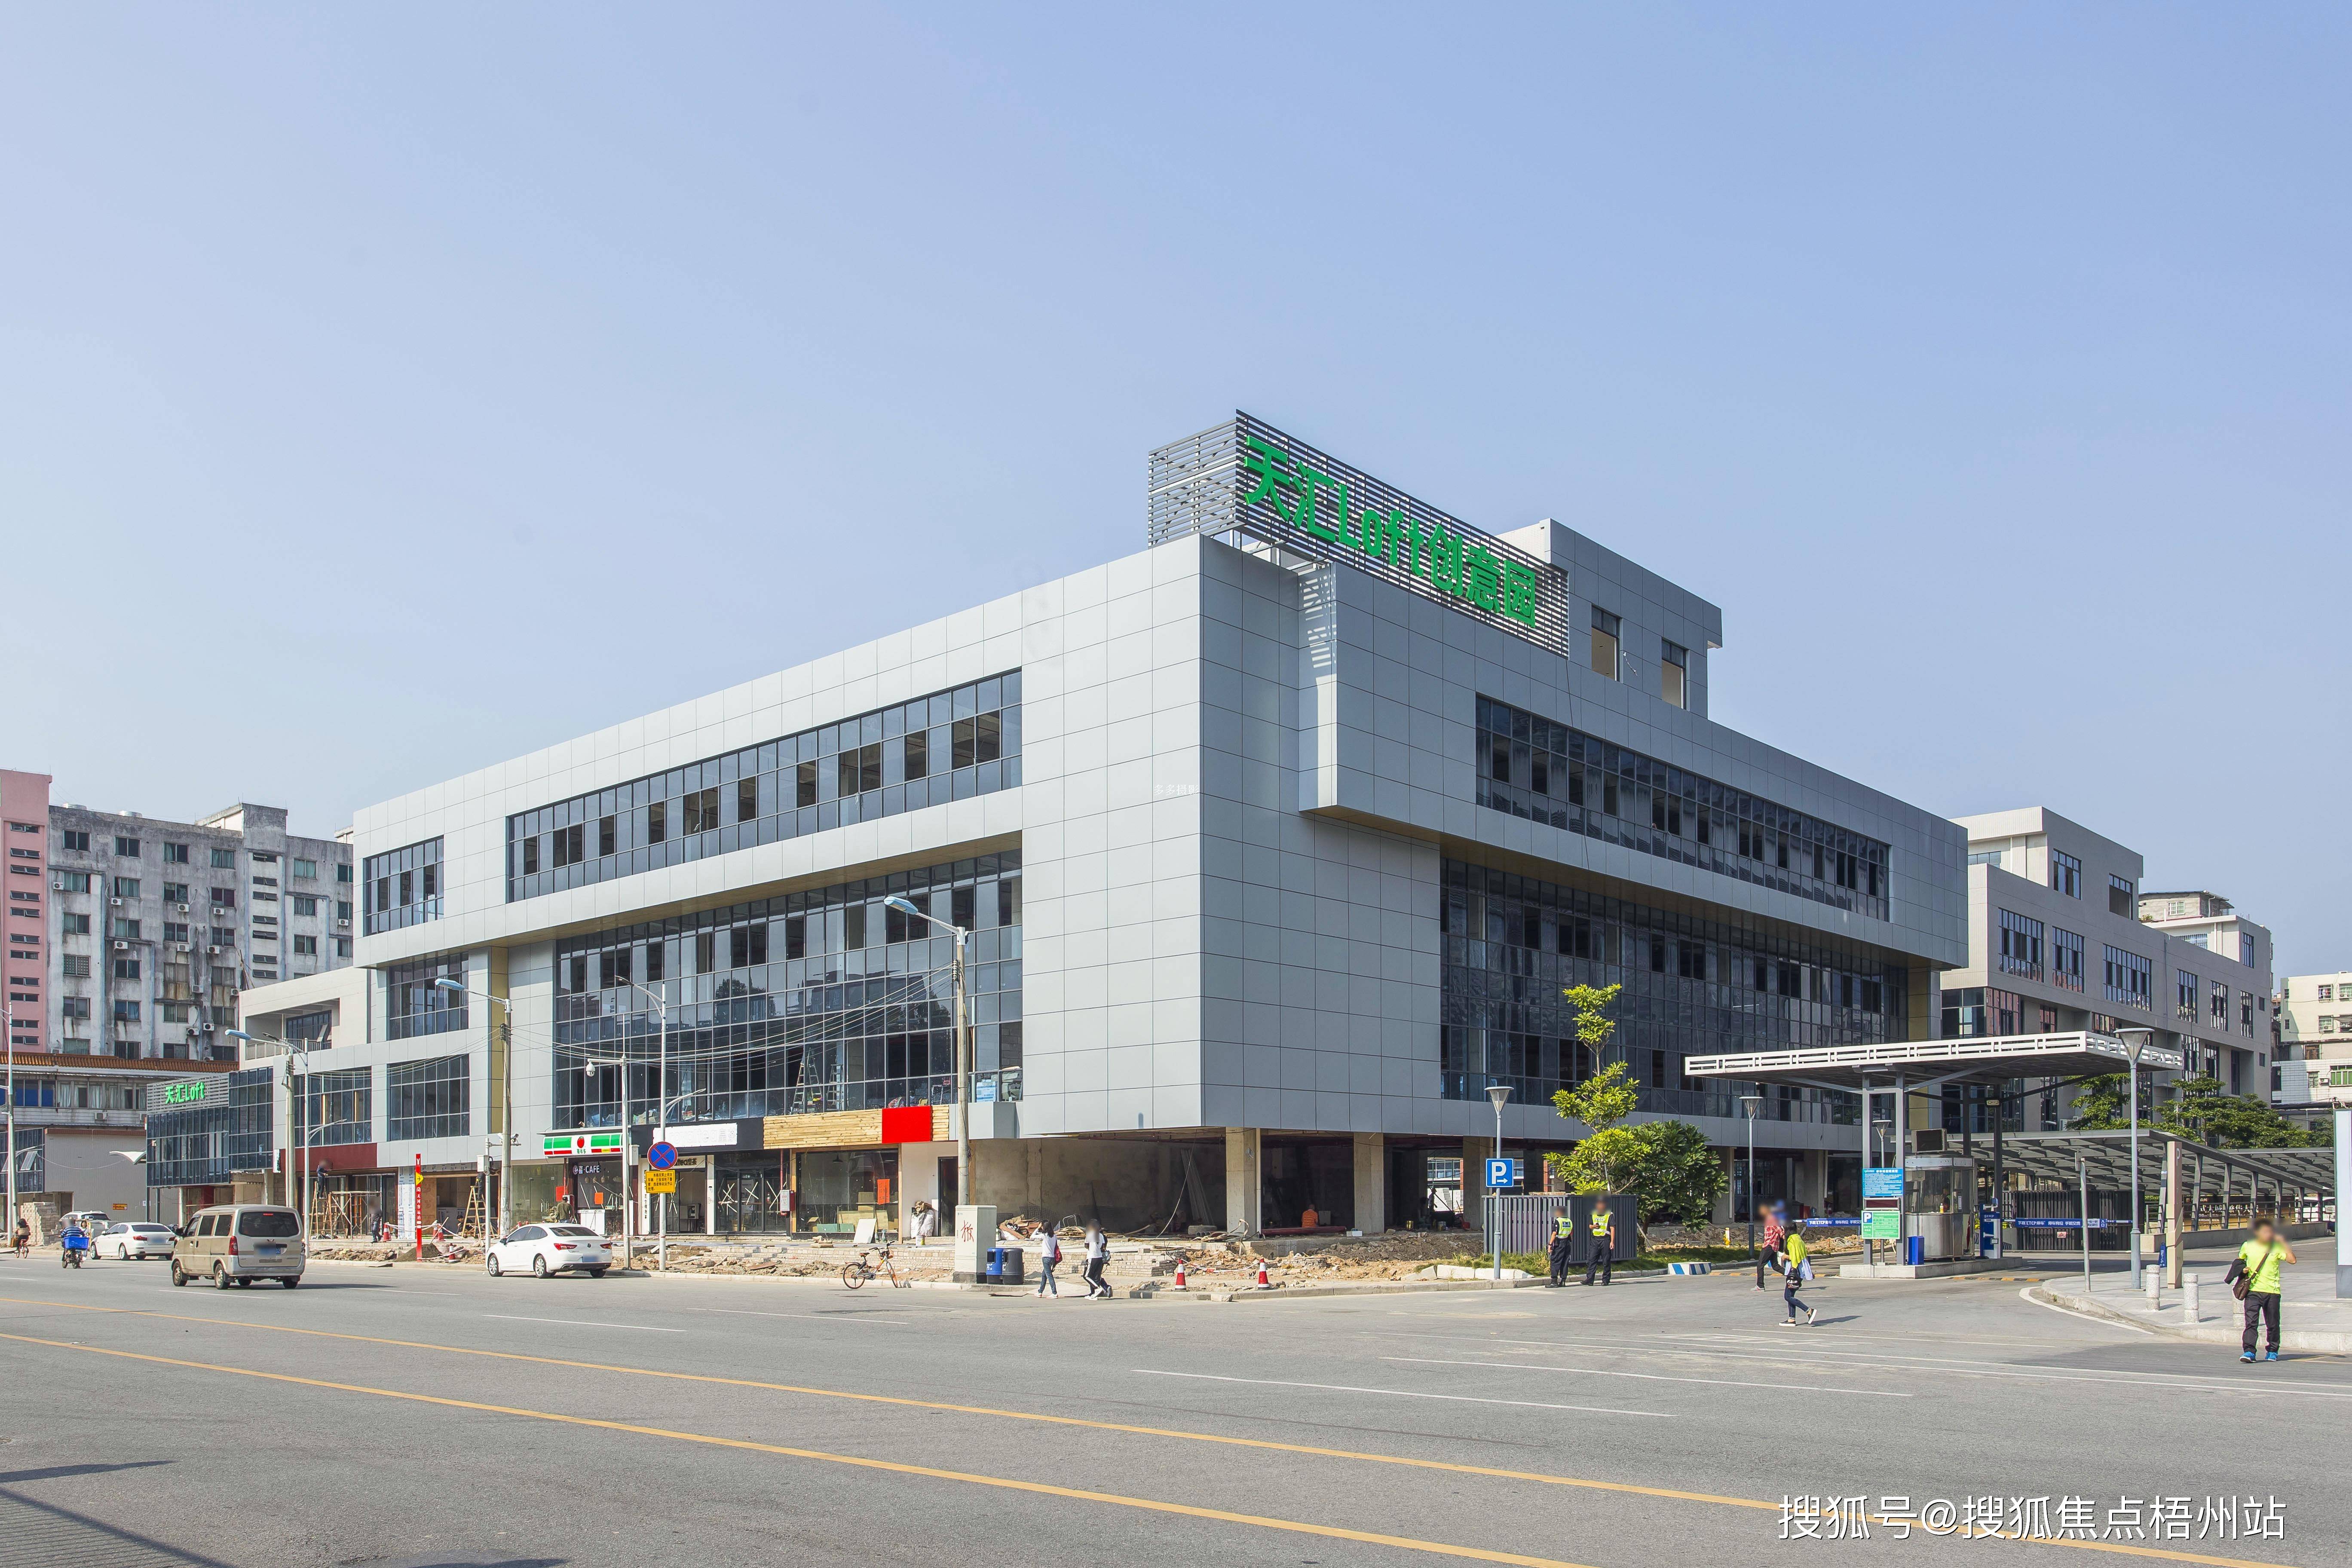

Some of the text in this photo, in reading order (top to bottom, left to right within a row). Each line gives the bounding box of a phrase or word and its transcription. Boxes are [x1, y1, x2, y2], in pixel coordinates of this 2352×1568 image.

[1243, 435, 1537, 628] 天汇Loft创意园
[165, 1082, 205, 1104] 天汇Loft
[1491, 1162, 1507, 1184] P
[1864, 1213, 1871, 1222] P
